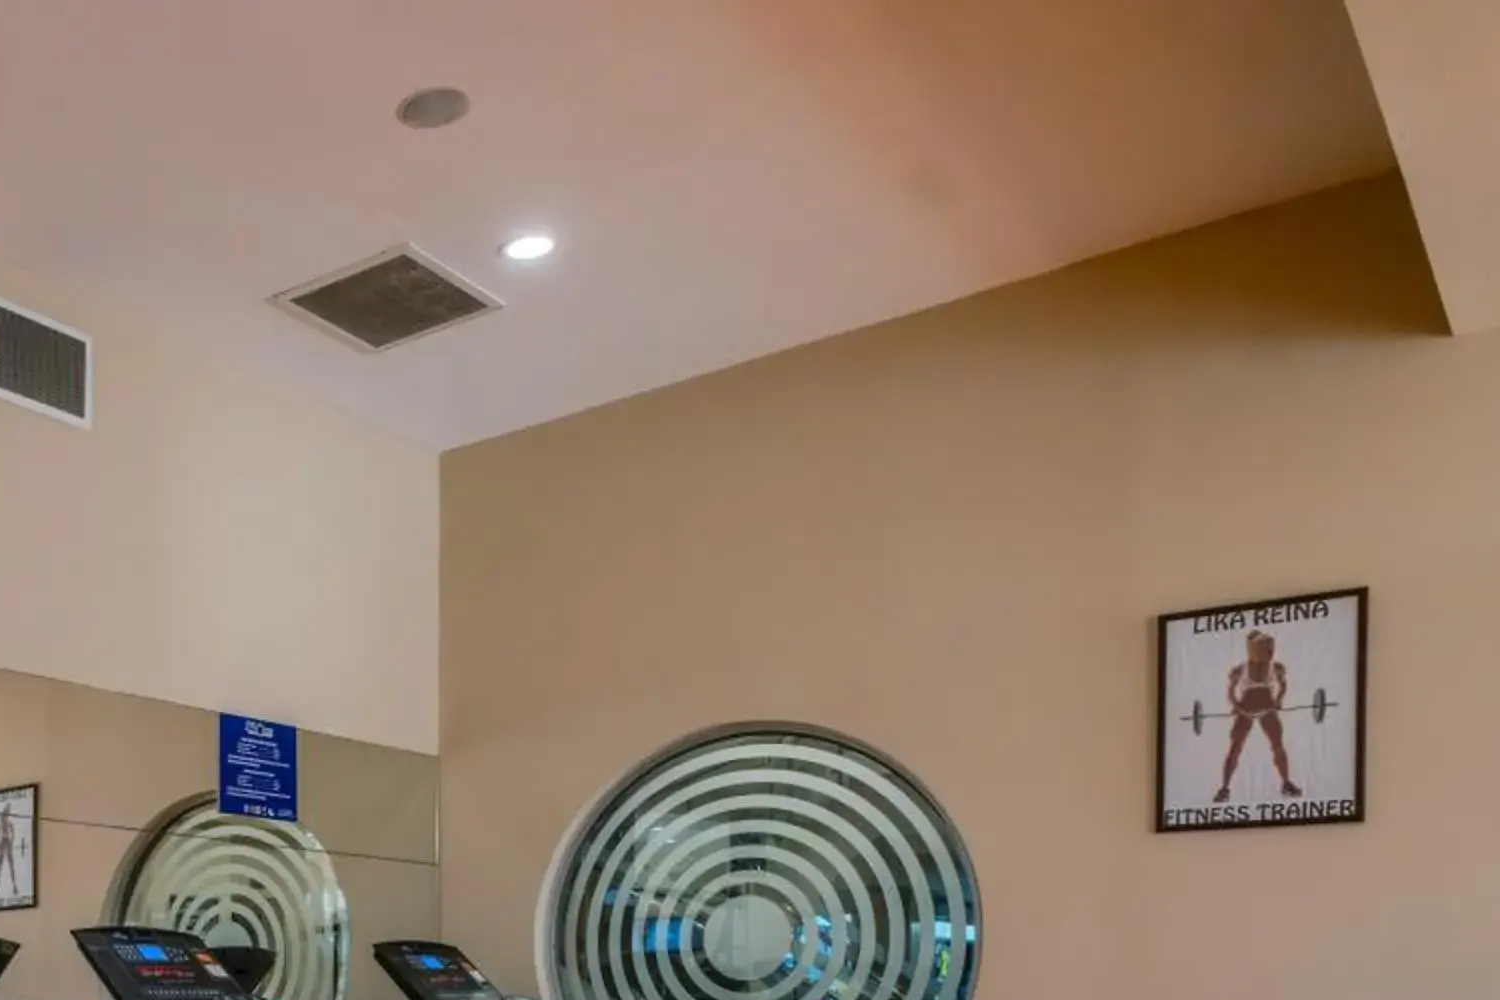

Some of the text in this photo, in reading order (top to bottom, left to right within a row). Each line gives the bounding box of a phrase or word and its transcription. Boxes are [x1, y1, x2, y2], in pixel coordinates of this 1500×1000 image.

[1193, 599, 1329, 634] LIKA REINA
[1164, 799, 1356, 826] FITNESS TRAINER
